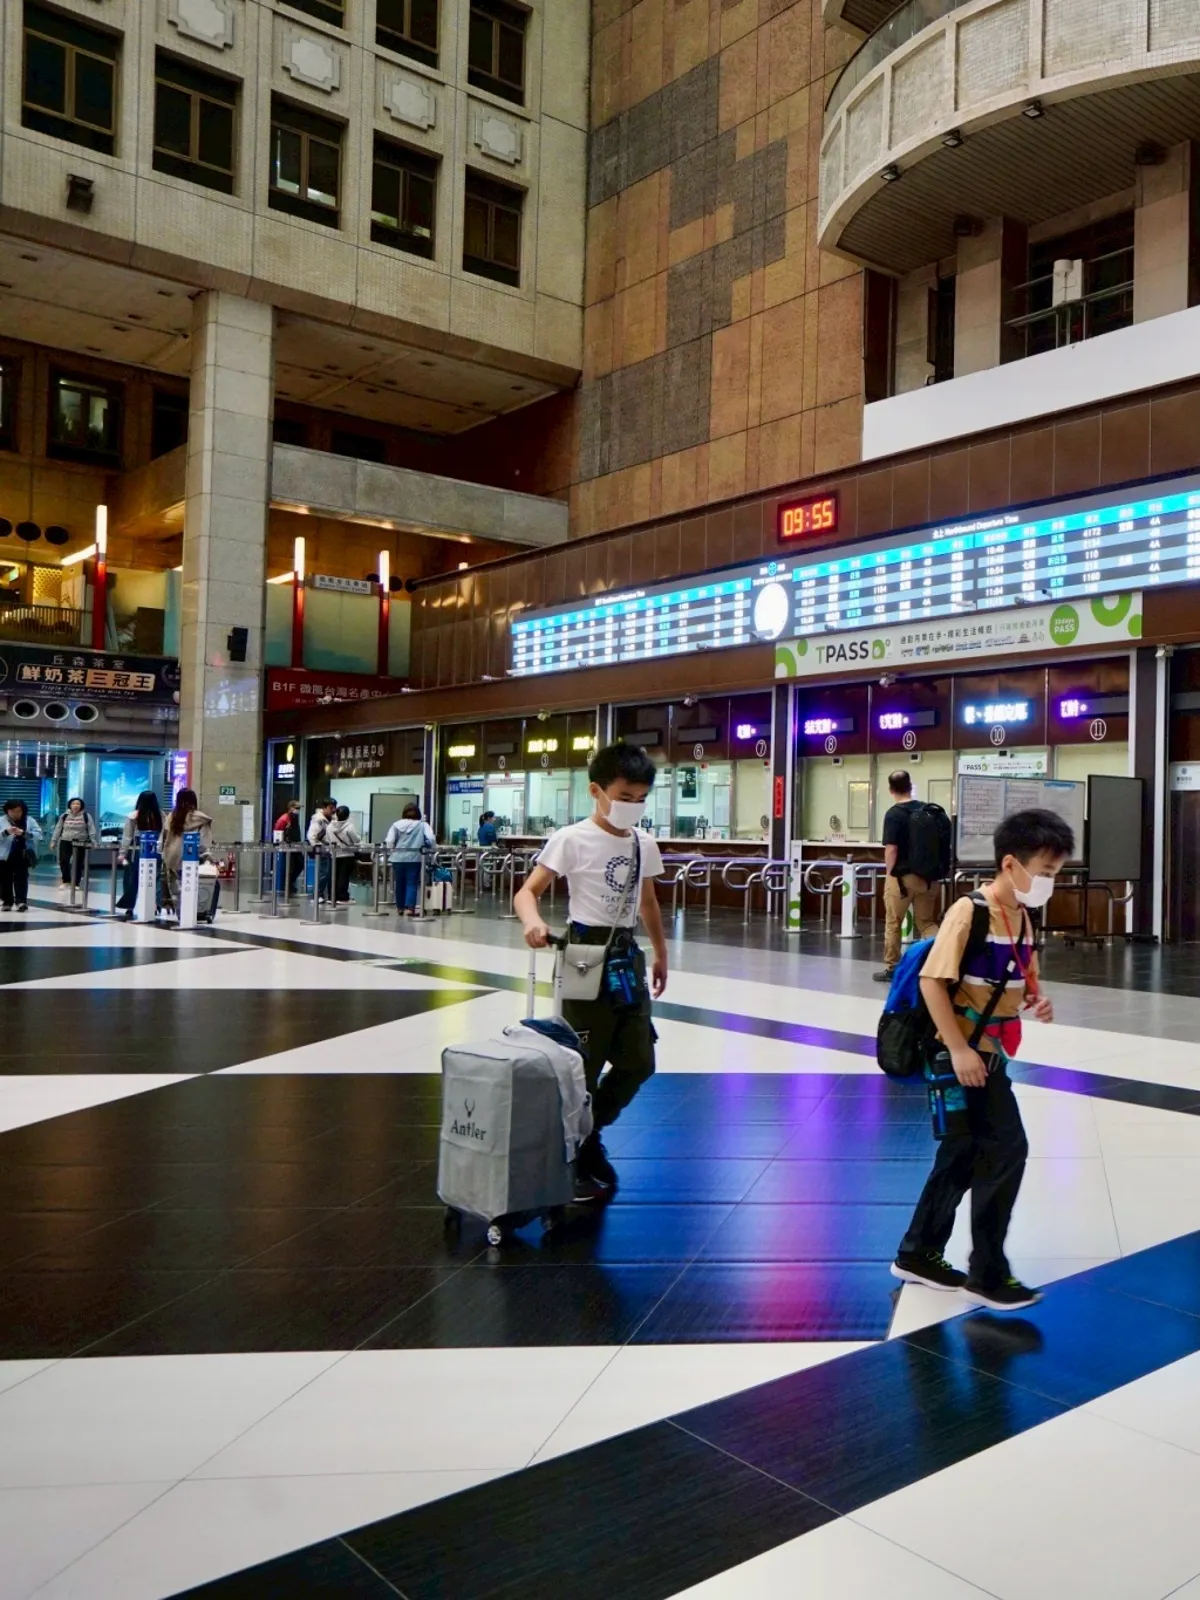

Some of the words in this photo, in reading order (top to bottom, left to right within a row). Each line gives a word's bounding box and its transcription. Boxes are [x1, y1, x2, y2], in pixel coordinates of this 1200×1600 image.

[783, 500, 833, 537] 09:55
[1054, 624, 1075, 634] PASS
[815, 640, 869, 665] TPASS
[22, 665, 152, 689] 鮮奶茶三冠王
[272, 681, 296, 692] B1F
[300, 683, 388, 698] 微風台灣名產中
[220, 787, 234, 795] F28
[600, 895, 622, 903] TOKY
[449, 1118, 487, 1141] Antler
